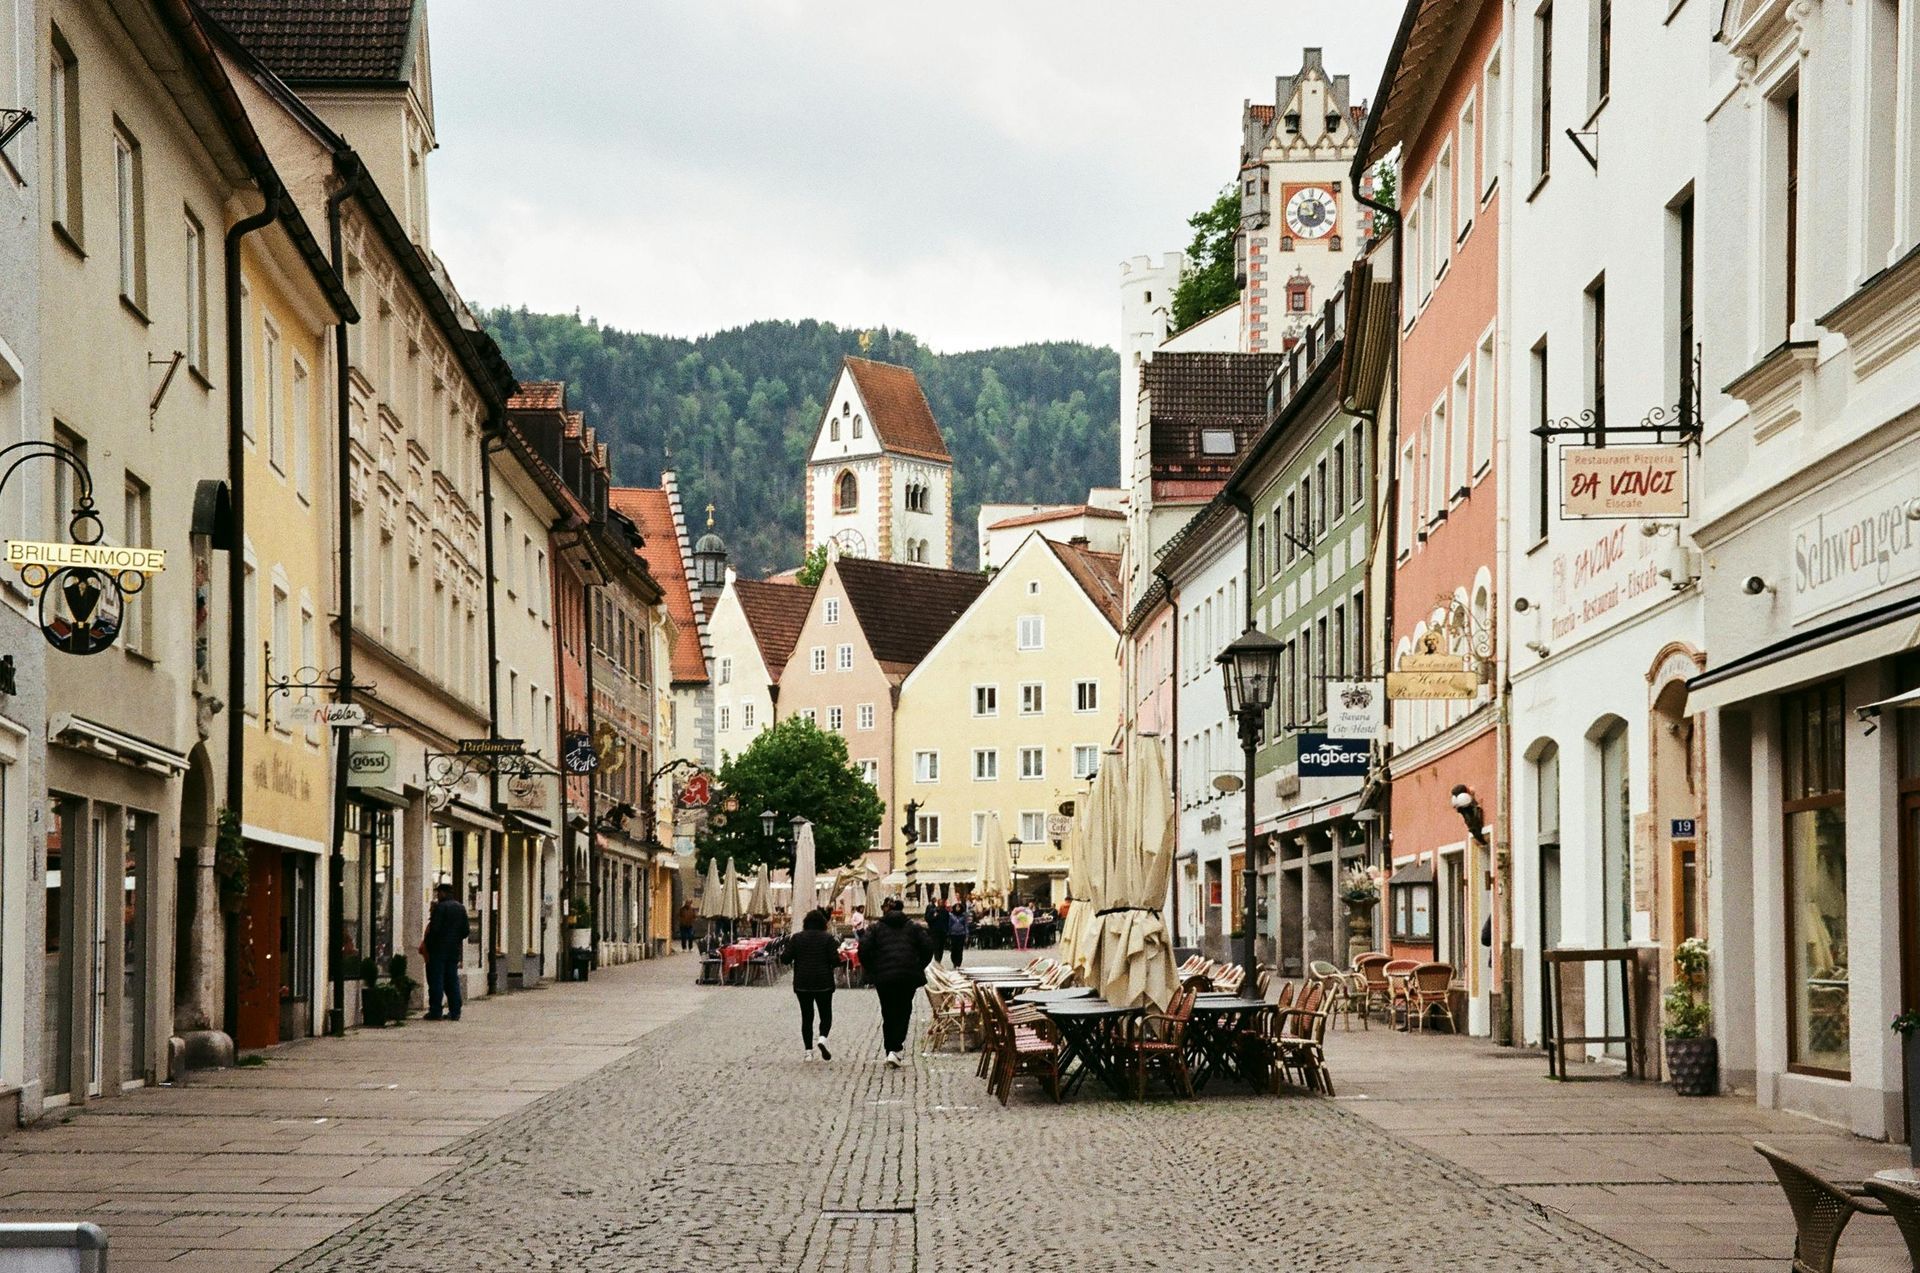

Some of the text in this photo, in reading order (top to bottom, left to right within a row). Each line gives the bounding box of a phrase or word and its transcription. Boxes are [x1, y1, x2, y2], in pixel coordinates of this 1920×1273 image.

[1575, 453, 1675, 465] Restaurant Pizzeria
[1571, 465, 1678, 500] DA VINCI
[10, 544, 163, 568] BRILLENMODE
[353, 756, 385, 770] gössl
[1300, 749, 1367, 767] engbers
[1677, 820, 1692, 832] 19
